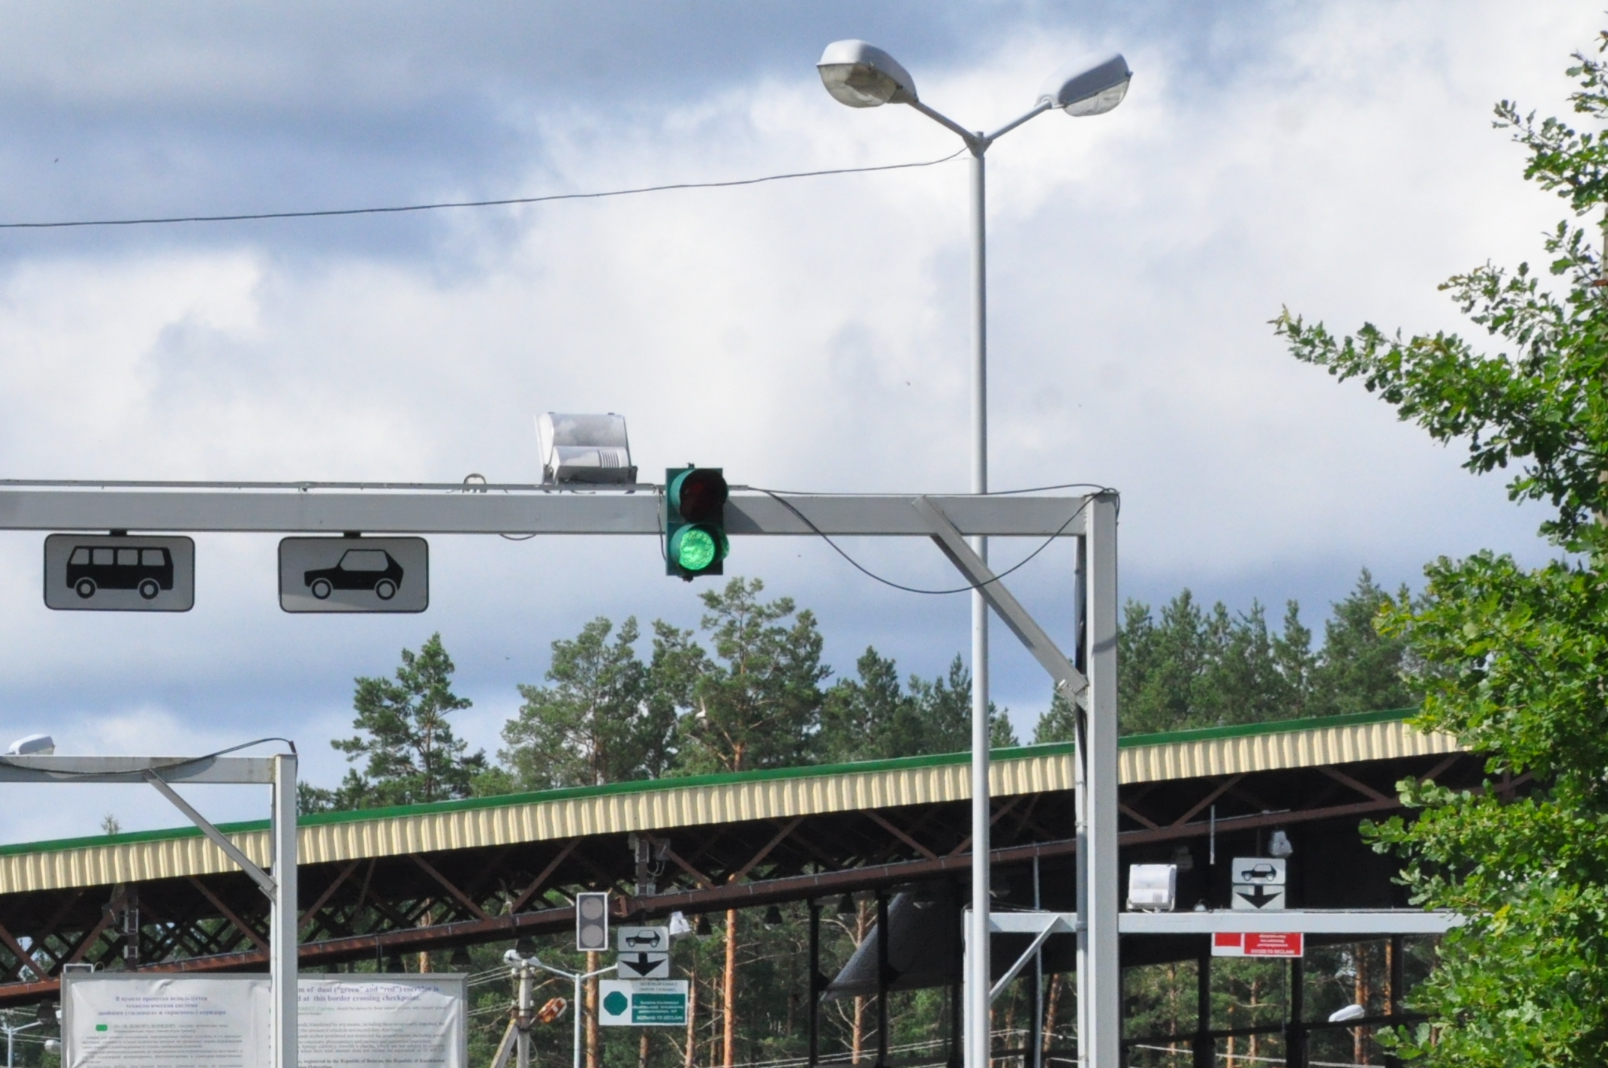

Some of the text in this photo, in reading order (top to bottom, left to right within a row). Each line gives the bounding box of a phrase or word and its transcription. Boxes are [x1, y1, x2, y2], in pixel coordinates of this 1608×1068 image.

[317, 985, 333, 993] dual
[313, 994, 327, 1002] this
[327, 994, 351, 1002] border
[352, 994, 381, 1003] crossing
